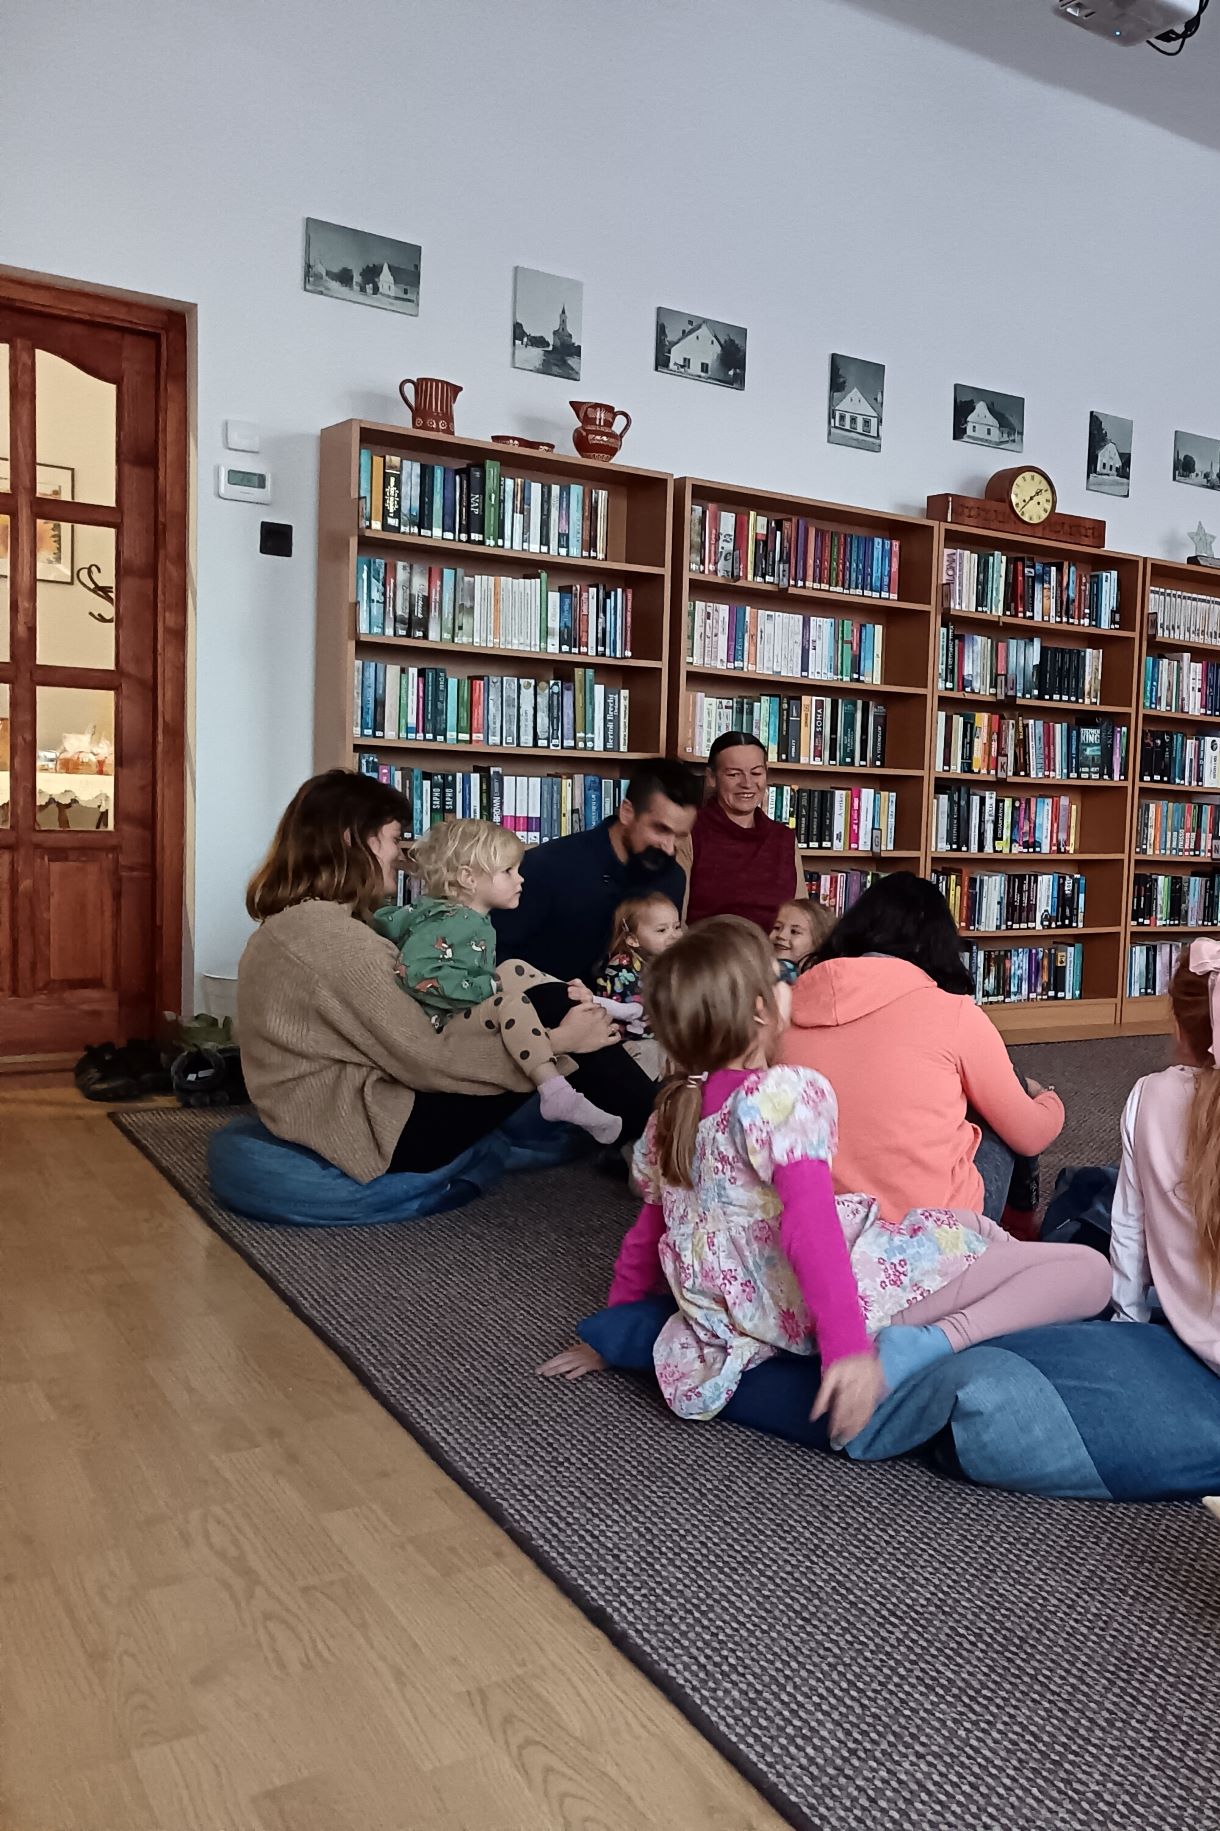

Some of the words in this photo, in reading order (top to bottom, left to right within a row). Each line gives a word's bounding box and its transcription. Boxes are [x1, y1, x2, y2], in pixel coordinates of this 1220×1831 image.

[470, 493, 480, 515] NAP
[606, 694, 614, 720] Brecht
[606, 722, 614, 748] Bertolt
[1080, 733, 1101, 743] KING
[1000, 760, 1006, 773] K
[492, 797, 501, 822] BROWN
